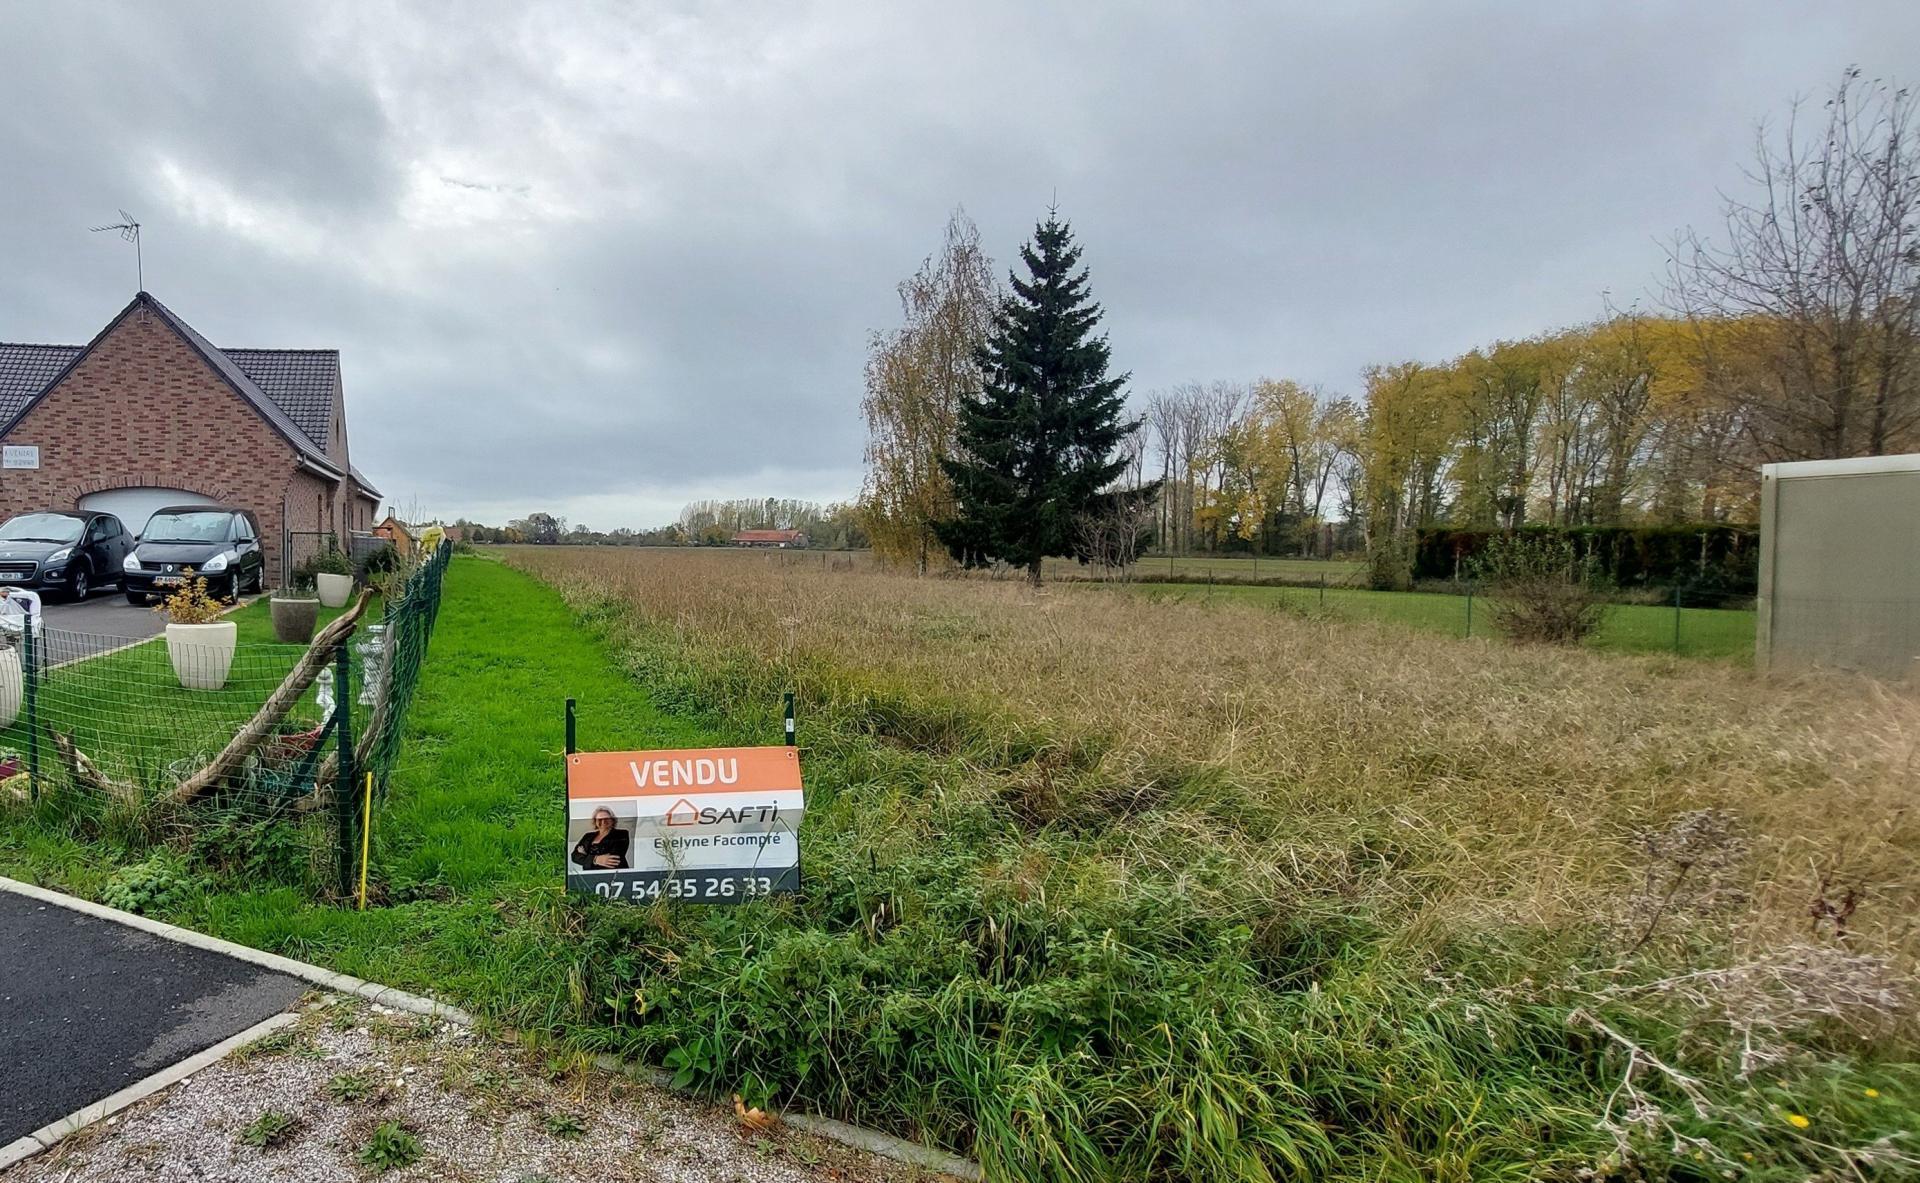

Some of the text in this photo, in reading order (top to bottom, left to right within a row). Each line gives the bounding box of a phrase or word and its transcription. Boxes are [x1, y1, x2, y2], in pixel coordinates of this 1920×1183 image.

[630, 757, 737, 787] VENDU
[654, 831, 781, 850] Evelyne Facompré
[595, 876, 771, 899] 07 54 35 26 33
